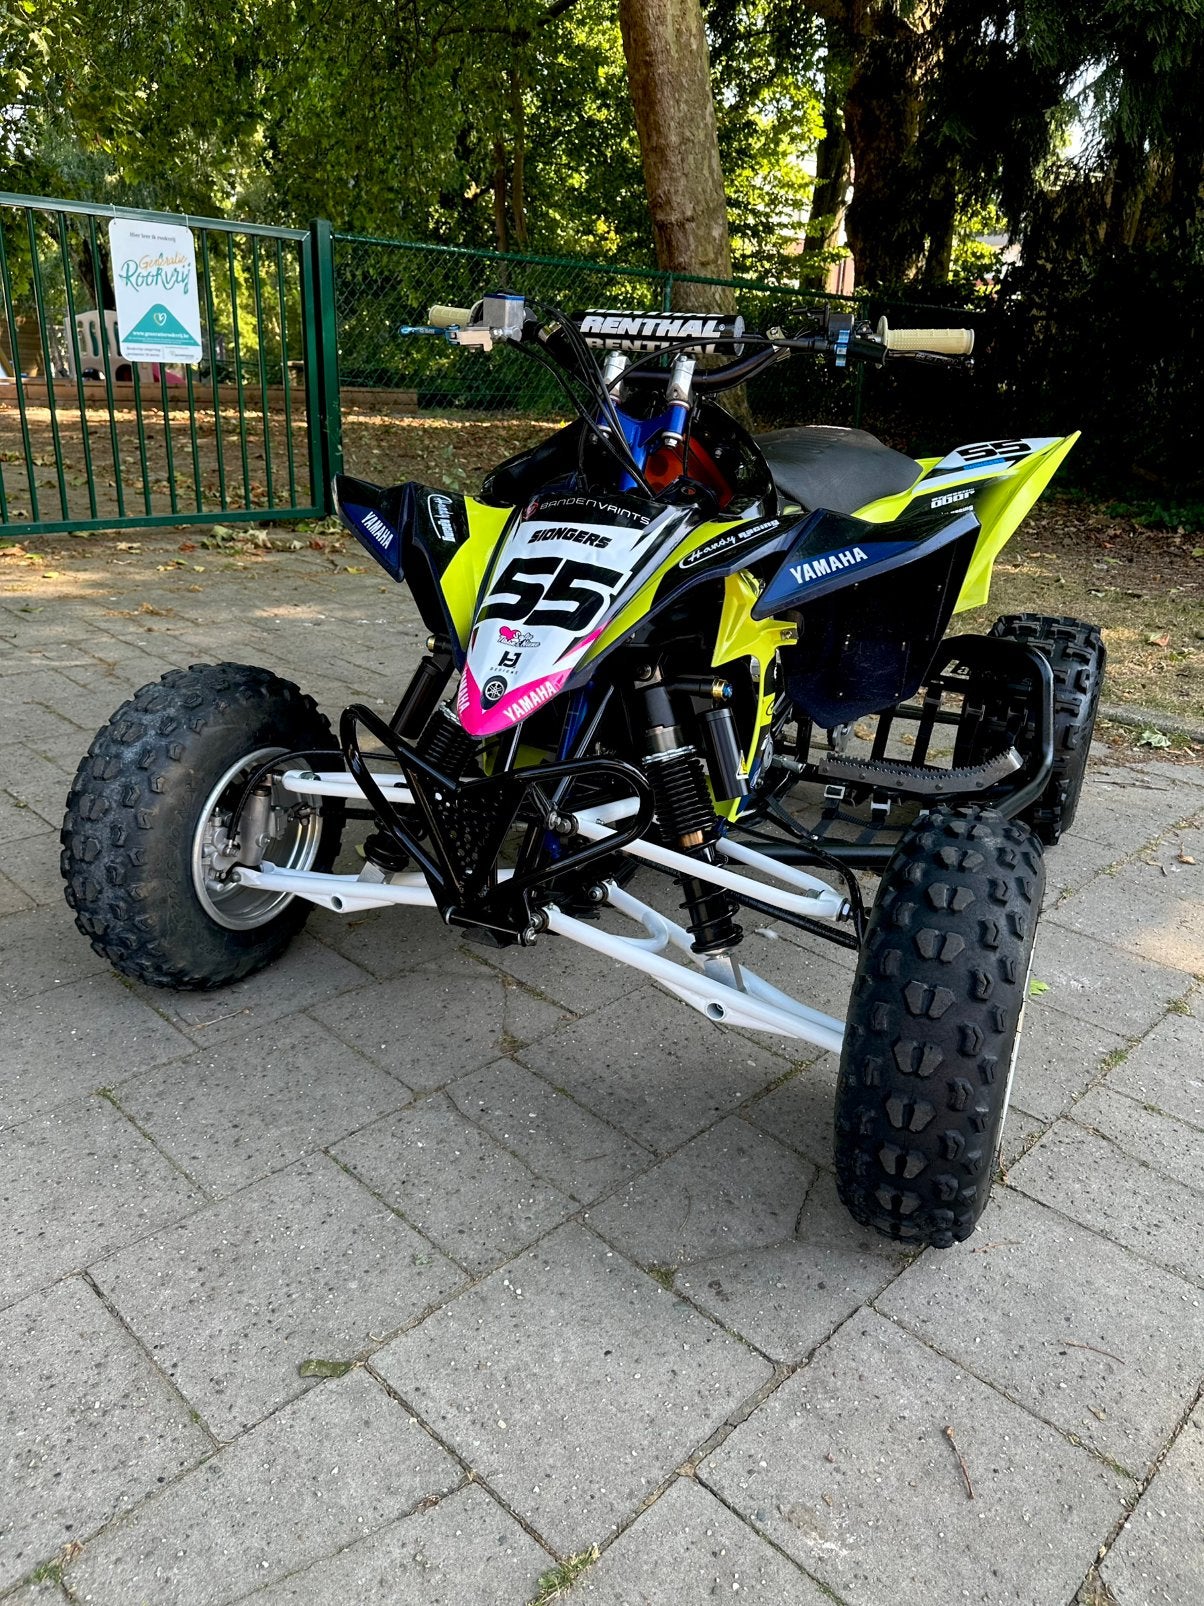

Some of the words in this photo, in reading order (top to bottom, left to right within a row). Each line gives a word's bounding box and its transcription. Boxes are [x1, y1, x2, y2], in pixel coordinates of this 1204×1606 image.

[580, 315, 721, 338] RENTHAL
[361, 511, 394, 550] YAMAHA
[687, 535, 736, 562] Handy
[789, 546, 869, 585] YAMAHA
[474, 556, 626, 632] 55
[502, 680, 558, 722] YAMAHA
